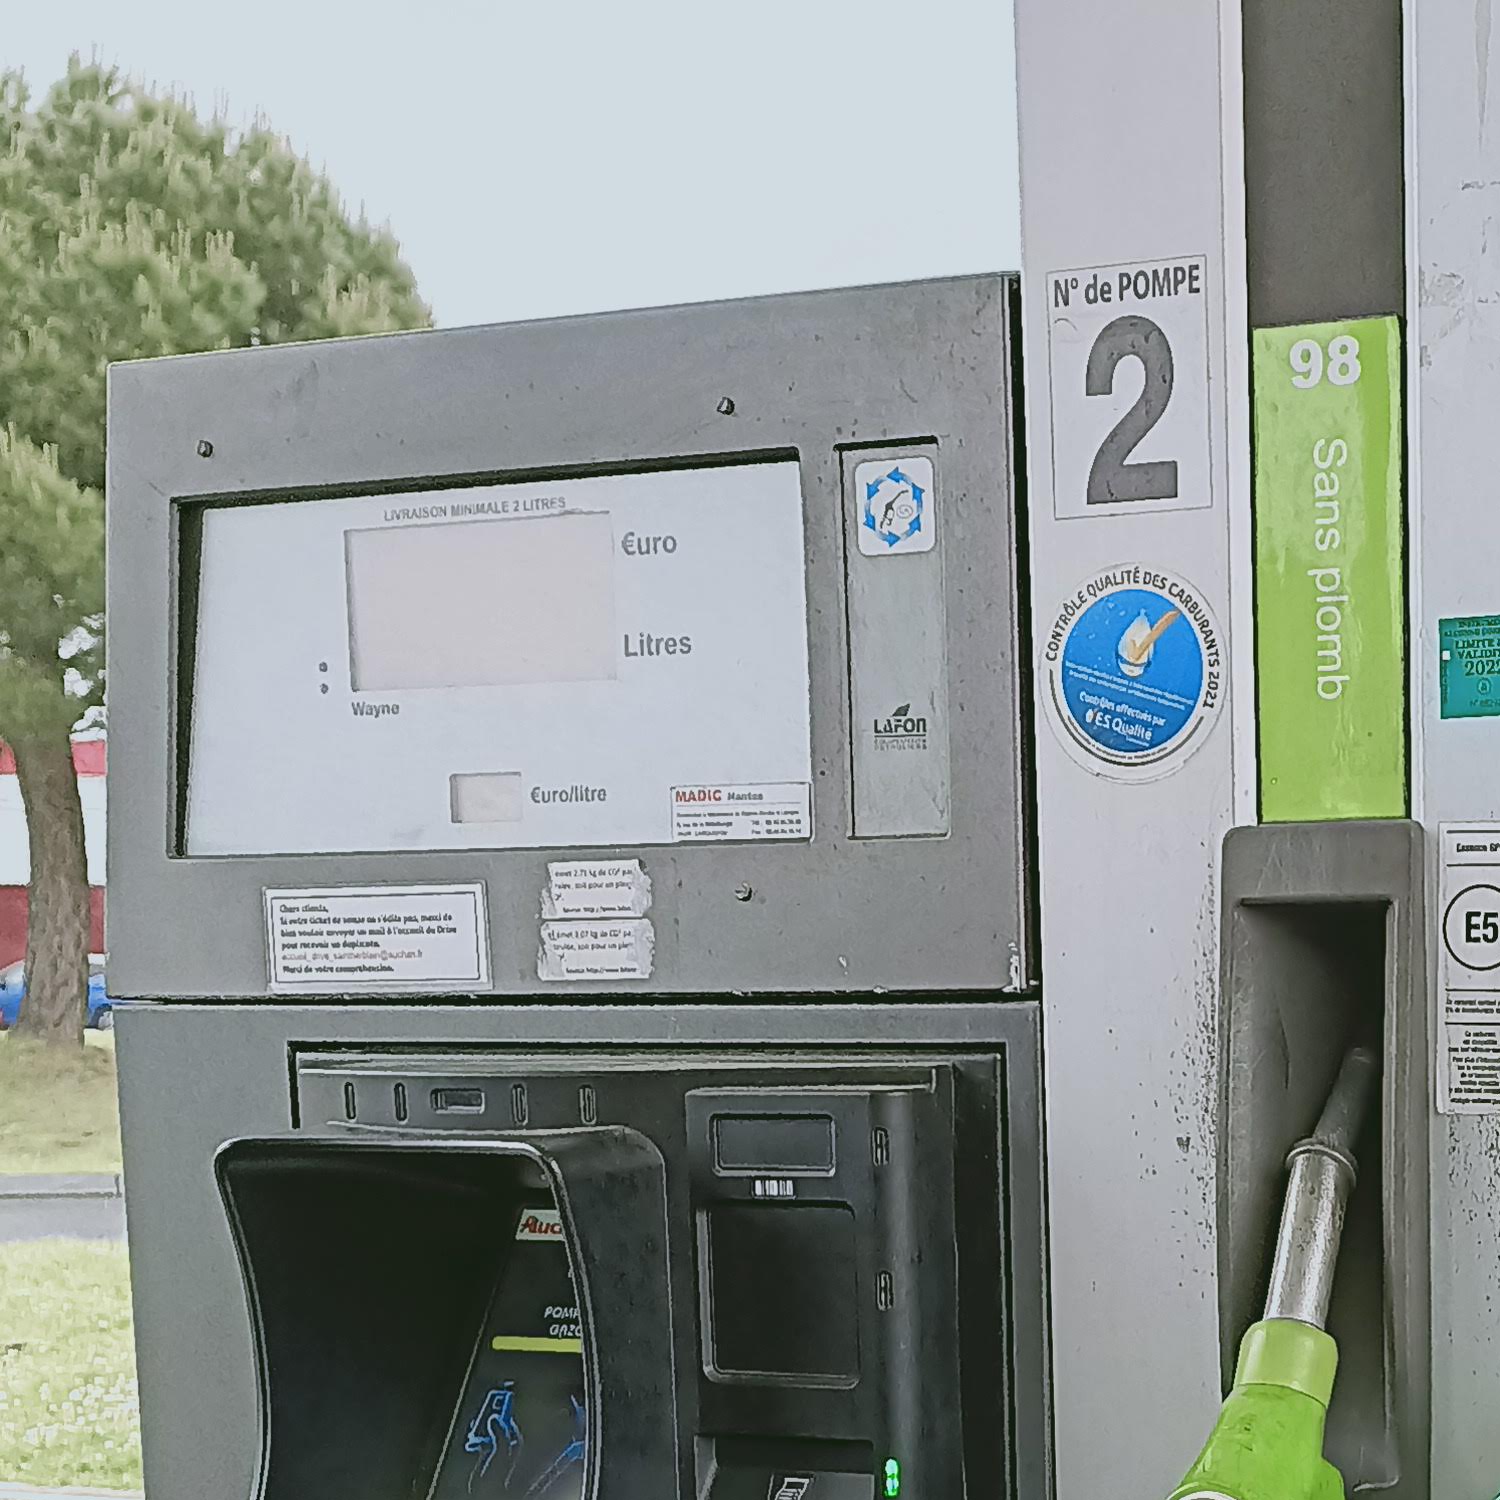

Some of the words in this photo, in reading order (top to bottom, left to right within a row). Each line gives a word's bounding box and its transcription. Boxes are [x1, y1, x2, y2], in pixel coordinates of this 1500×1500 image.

[1054, 276, 1079, 308] N°
[1084, 273, 1112, 305] de
[1118, 264, 1200, 302] POMPE
[1289, 335, 1362, 389] 98
[1086, 314, 1178, 505] 2
[384, 506, 447, 522] LIVRAISON
[451, 501, 509, 517] MINIMALE
[513, 501, 519, 512] 2
[523, 496, 566, 511] LITRES
[1312, 438, 1348, 551] Sans
[621, 532, 677, 556] €uro
[624, 632, 692, 657] Litres
[1044, 591, 1088, 662] CONTRÔLE
[1086, 566, 1140, 598] QUALITÉ
[1142, 570, 1168, 590] DES
[1168, 582, 1220, 668] CARBURANTS
[1202, 671, 1220, 709] 2021
[1307, 567, 1350, 700] plomb
[351, 701, 400, 718] Wayne
[530, 785, 607, 804] €uro/litre
[675, 789, 722, 802] MADIC
[1465, 911, 1499, 944] E5
